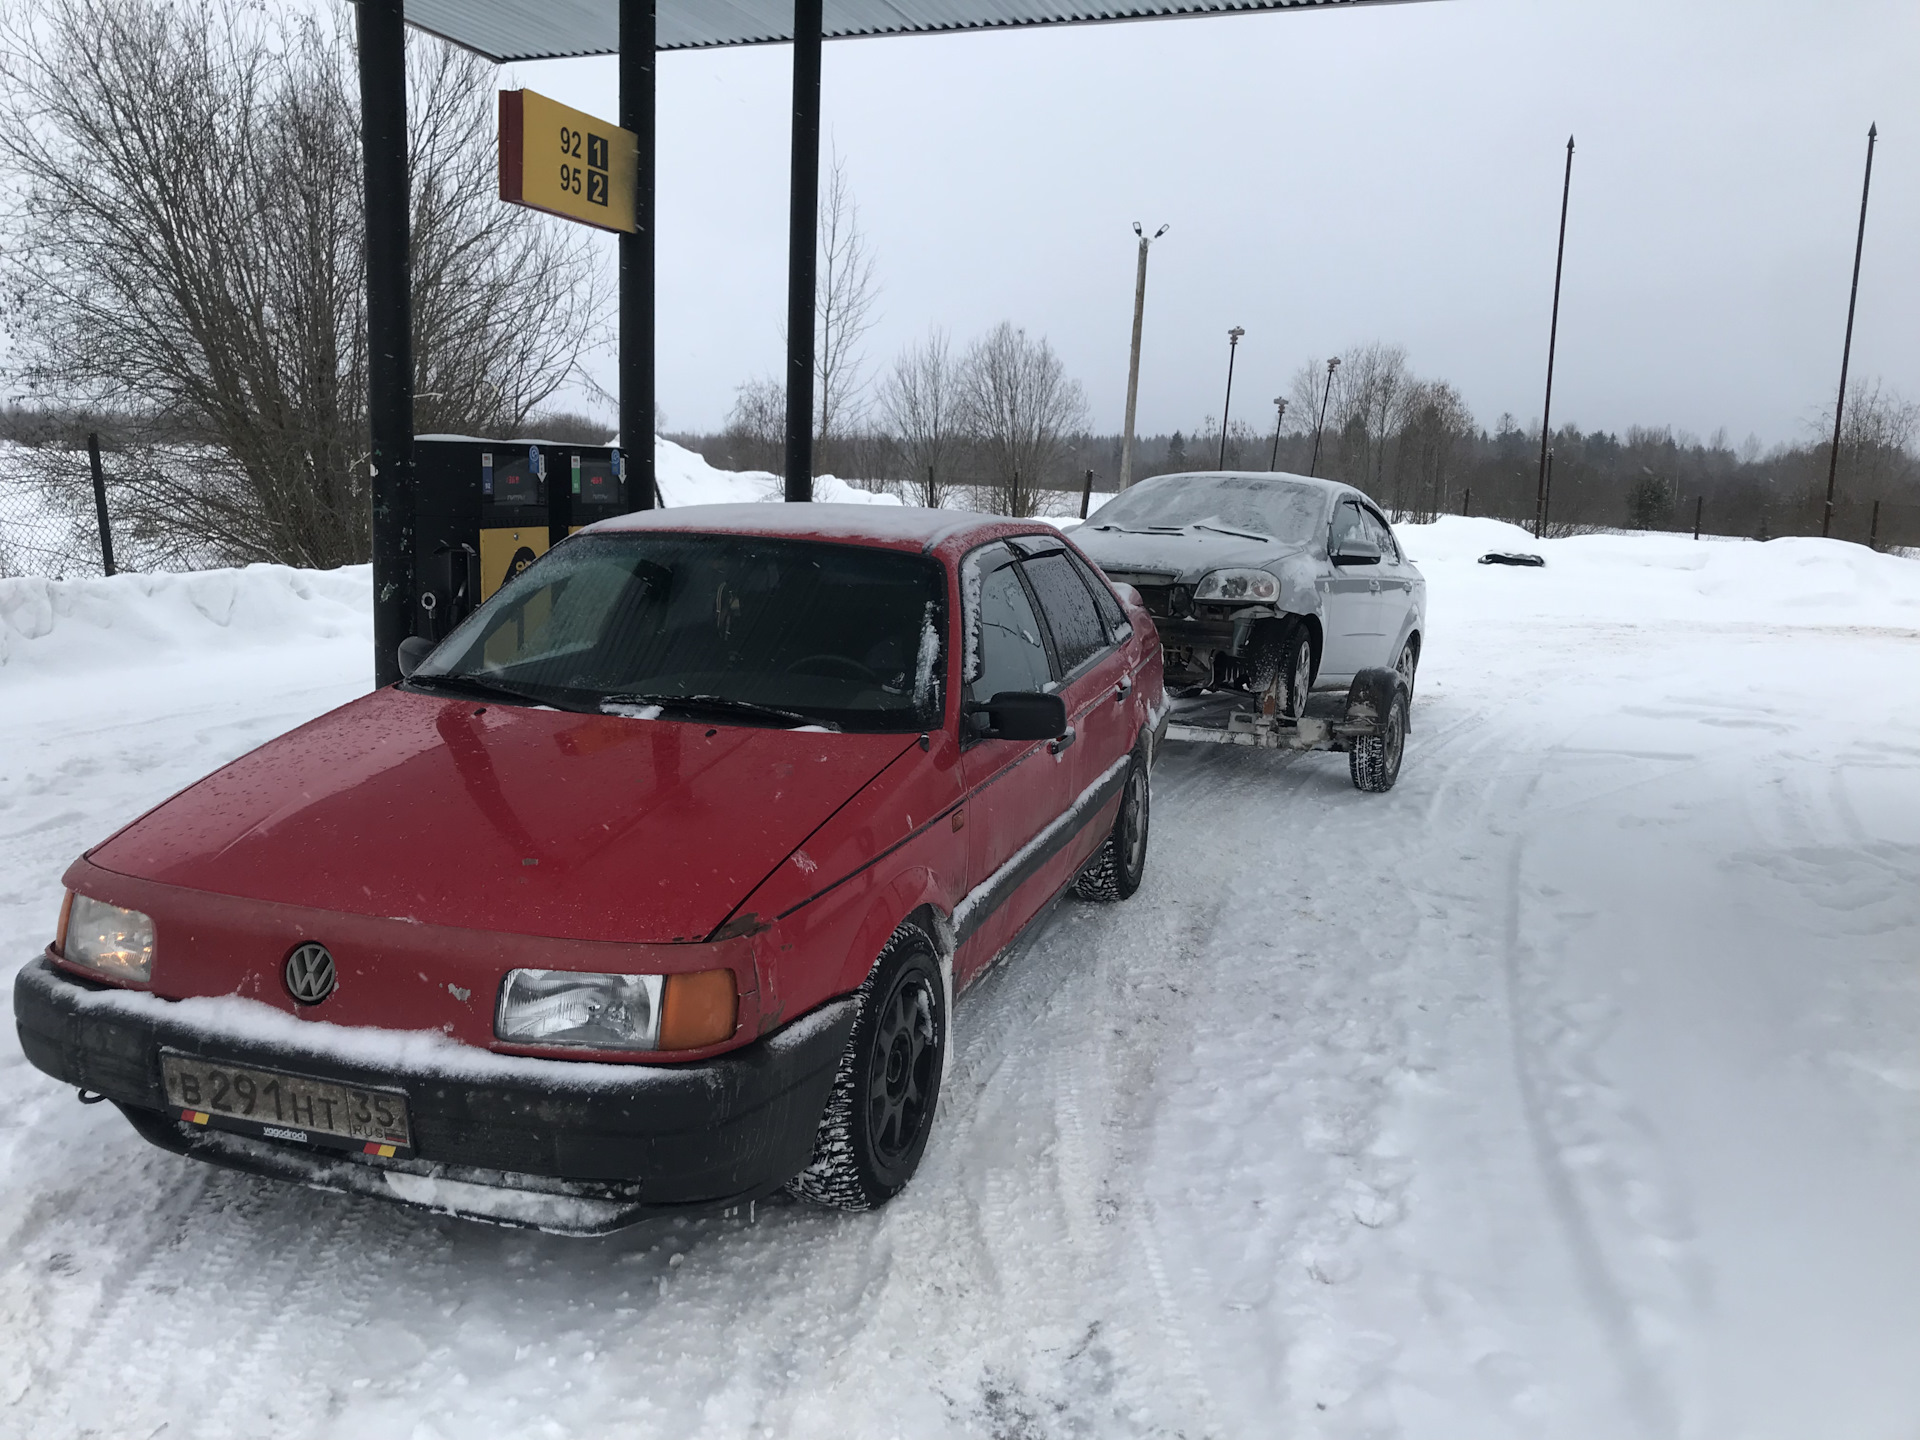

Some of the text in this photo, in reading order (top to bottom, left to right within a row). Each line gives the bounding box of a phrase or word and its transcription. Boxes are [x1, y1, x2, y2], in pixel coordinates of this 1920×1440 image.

[560, 126, 602, 167] 92 1
[560, 163, 604, 203] 95 2
[351, 1091, 395, 1128] 35
[353, 1123, 385, 1139] RUS
